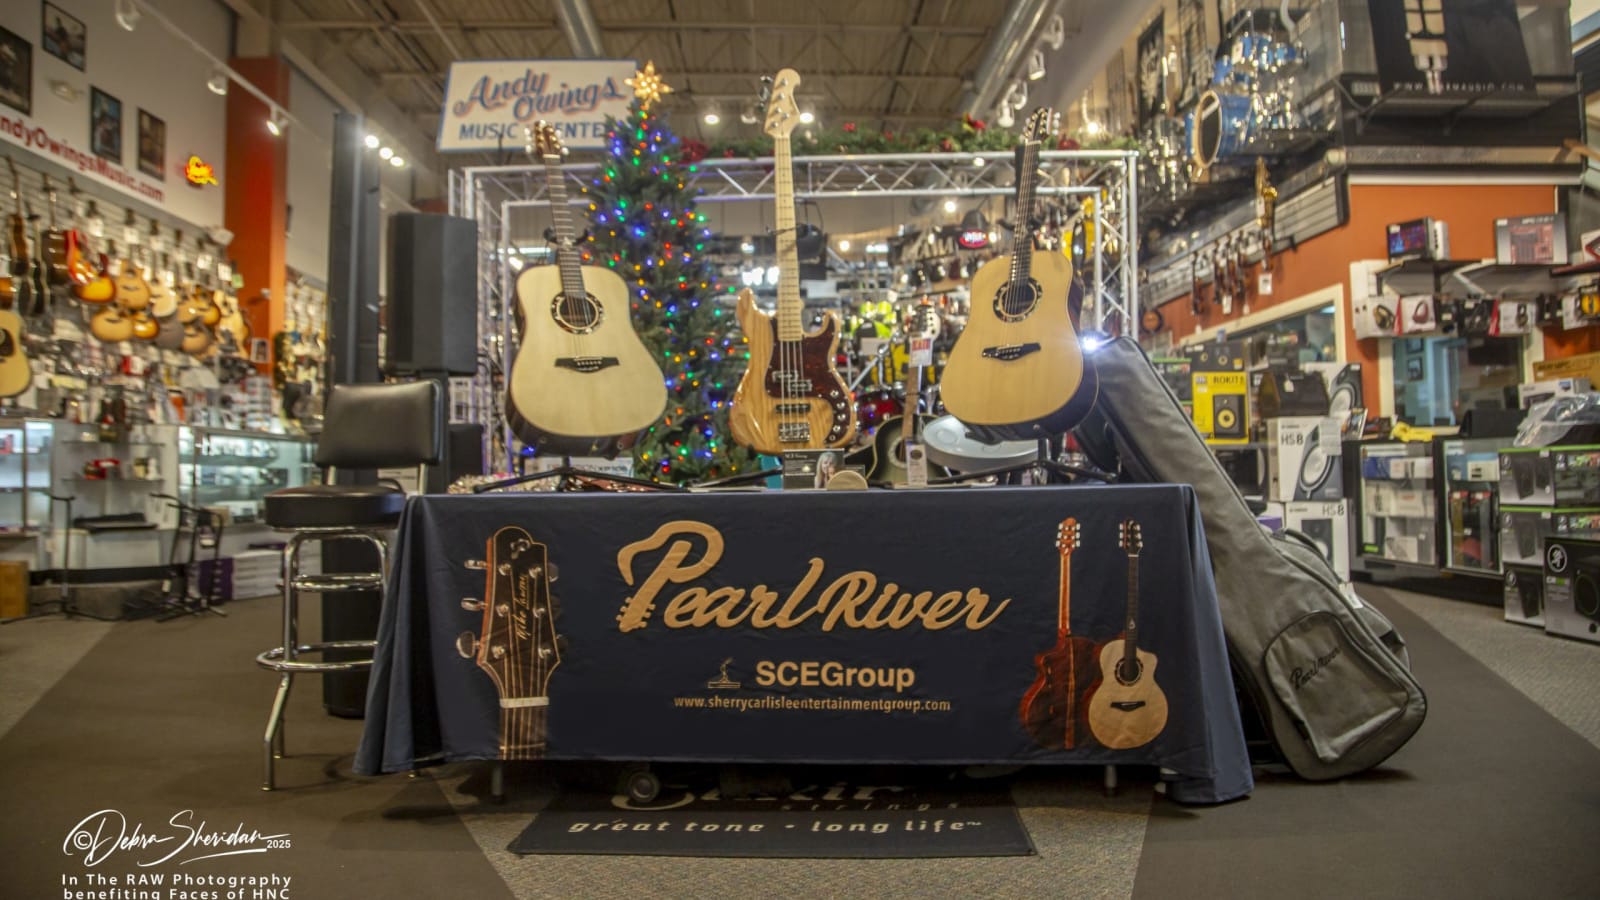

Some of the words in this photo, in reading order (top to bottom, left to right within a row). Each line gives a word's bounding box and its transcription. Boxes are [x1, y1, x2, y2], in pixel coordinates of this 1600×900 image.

[453, 69, 549, 117] Andy
[512, 77, 627, 121] Owings
[459, 123, 519, 140] MUSIC
[527, 122, 610, 138] ENTE
[0, 116, 163, 201] ndyOwingsMusic.com
[1281, 433, 1304, 446] HS8
[1322, 503, 1345, 516] HS8
[756, 661, 915, 692] SCEGroup
[674, 695, 952, 713] www.sherrycarlisleentertainmentgroup.com
[567, 820, 670, 833] great
[684, 821, 765, 832] tone
[811, 820, 889, 833] long
